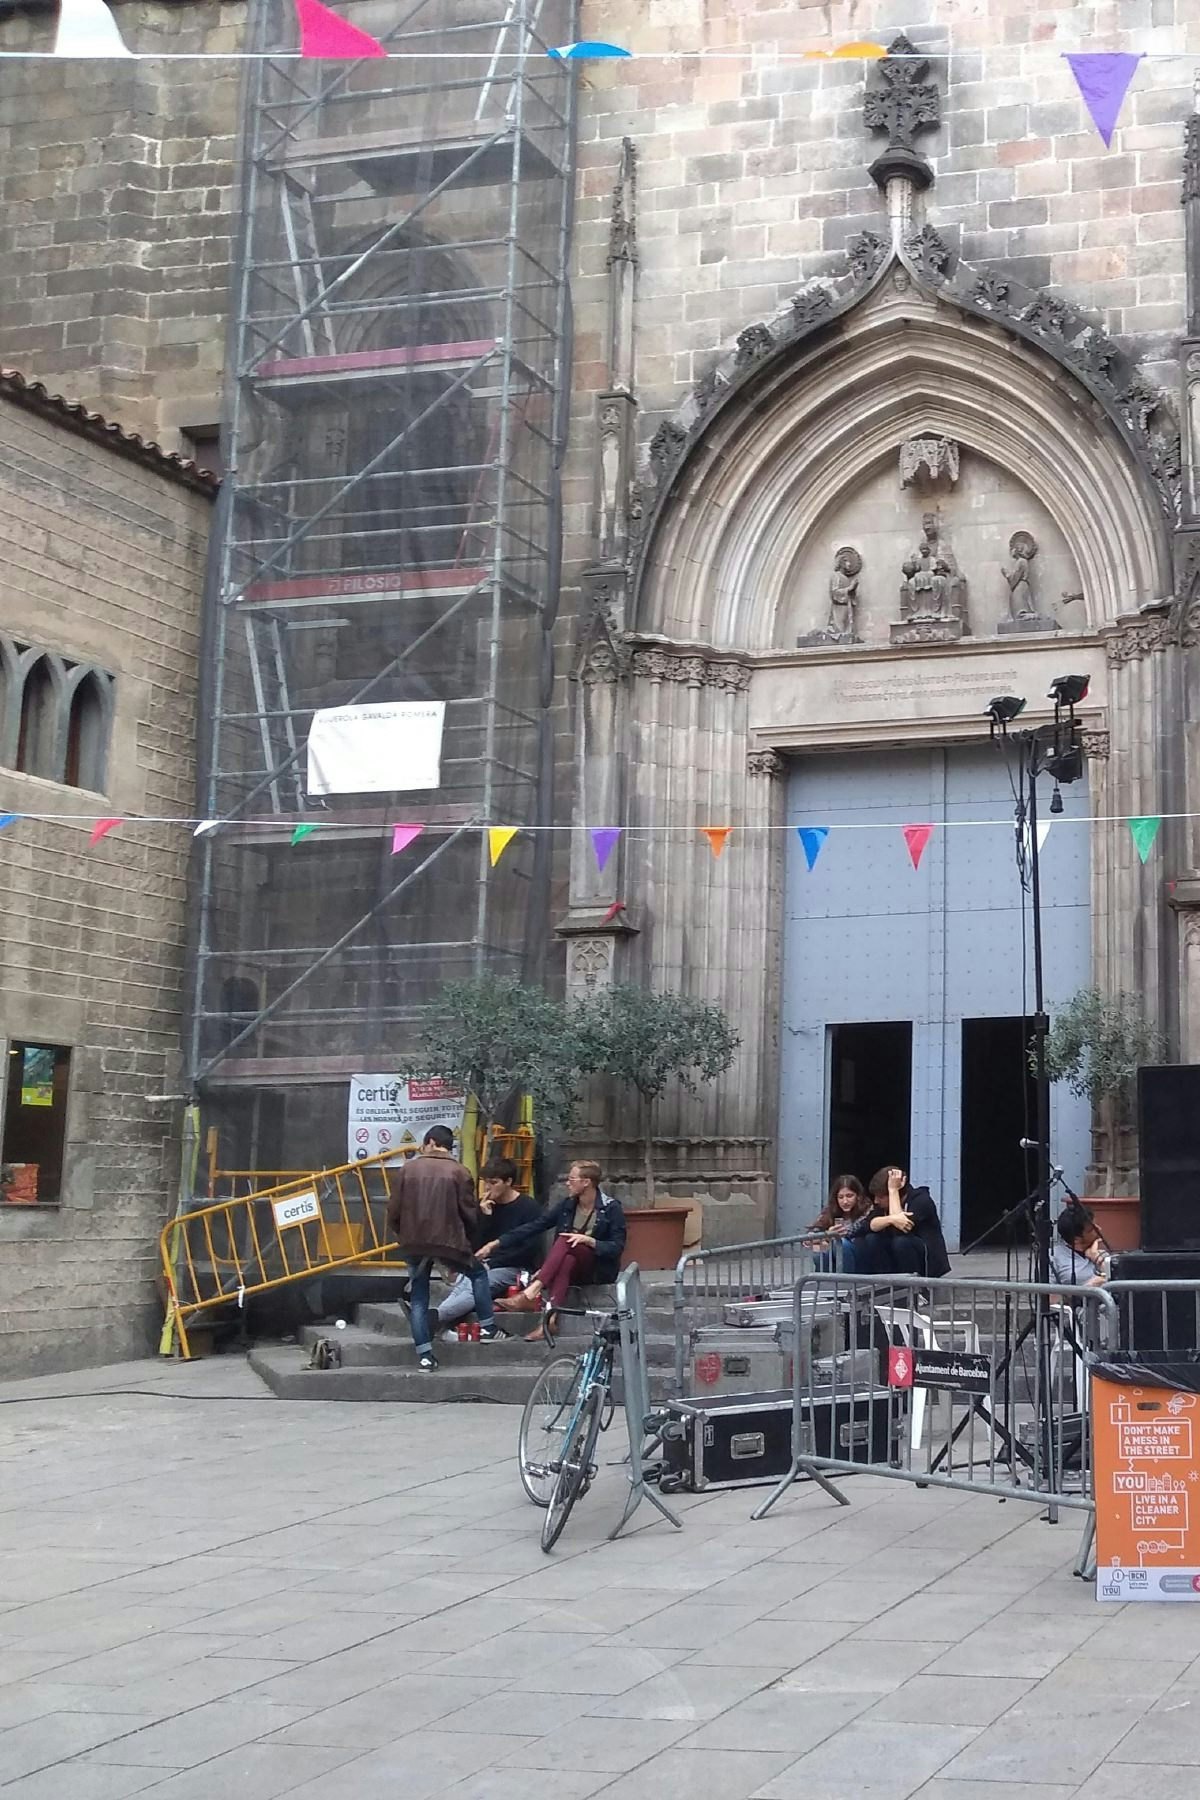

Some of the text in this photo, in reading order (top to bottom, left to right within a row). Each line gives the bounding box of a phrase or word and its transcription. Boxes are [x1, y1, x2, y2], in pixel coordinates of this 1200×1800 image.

[415, 1111, 461, 1122] SEGURETAT
[283, 1201, 314, 1219] certis
[915, 1363, 988, 1379] Ajuntament de Barcelona
[1123, 1426, 1181, 1435] DON'T MAKE
[1123, 1436, 1170, 1445] A MESS IN
[1124, 1446, 1180, 1455] THE STREET
[1116, 1476, 1144, 1489] YOU
[1135, 1495, 1178, 1504] LIVE IN A
[1135, 1505, 1179, 1515] CLEANER
[1135, 1515, 1157, 1525] CITY
